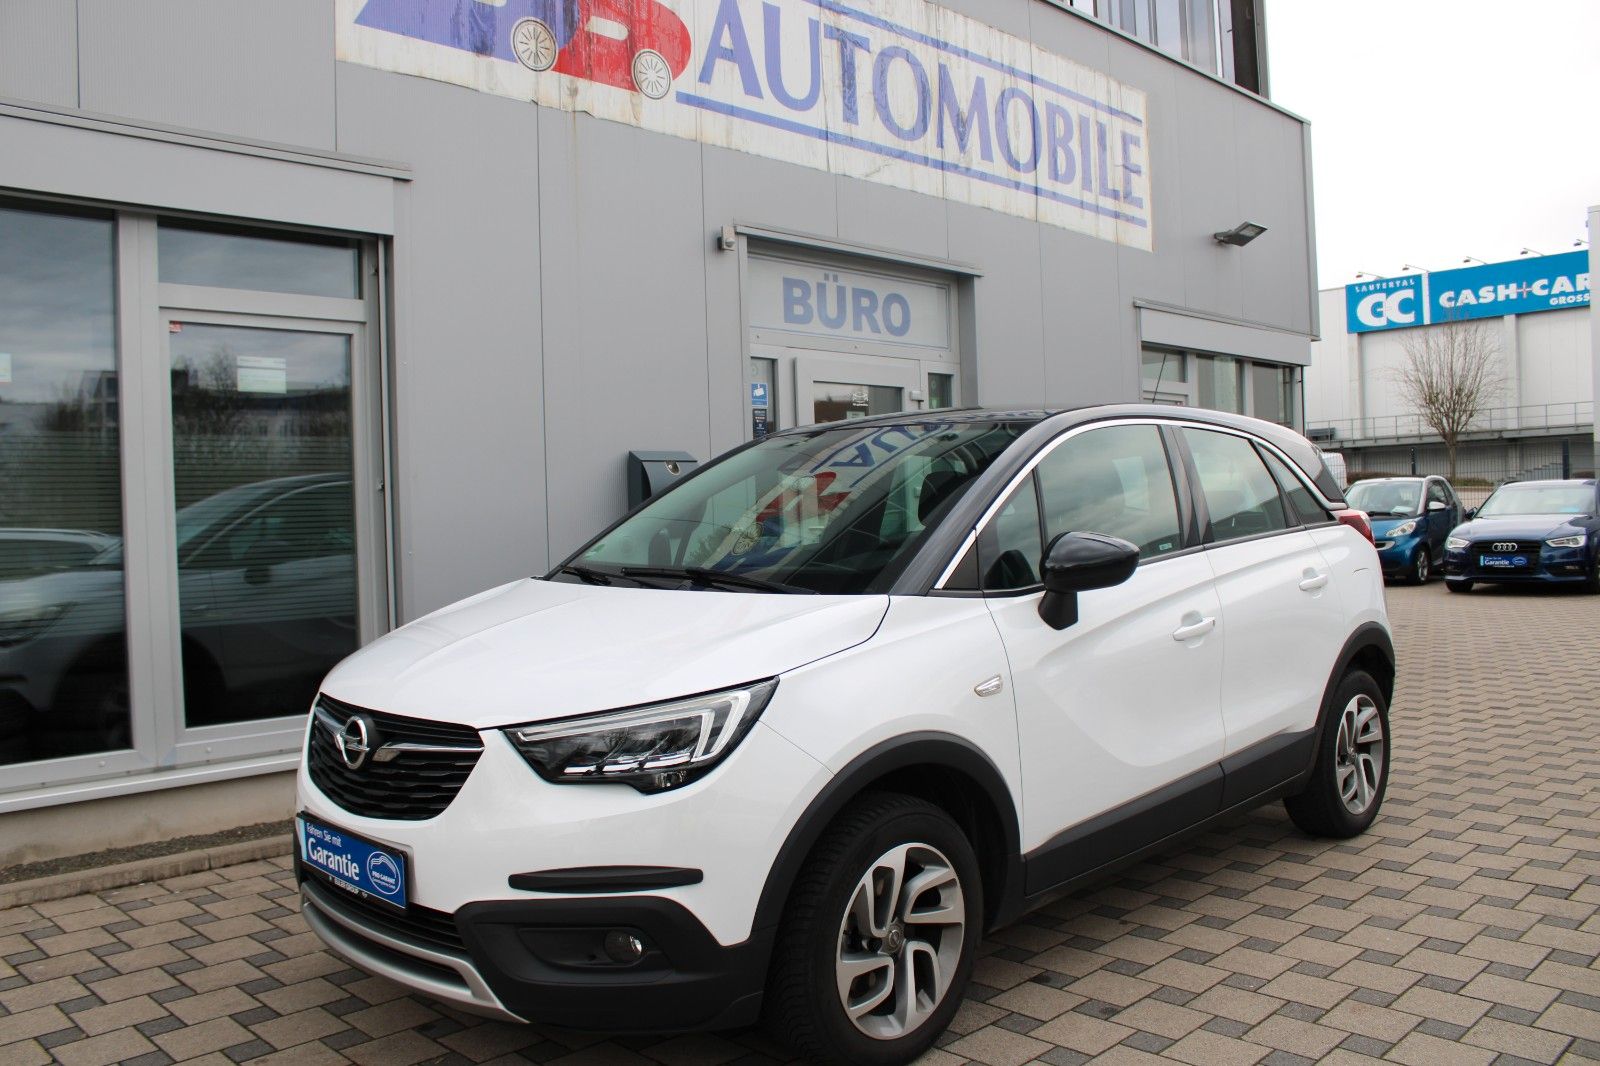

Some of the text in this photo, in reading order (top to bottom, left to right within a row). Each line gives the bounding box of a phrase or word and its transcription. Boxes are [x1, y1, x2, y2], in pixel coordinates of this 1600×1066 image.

[698, 0, 1143, 209] AUTOMOBILE
[782, 273, 911, 337] BÜRO
[1355, 279, 1415, 293] LAUTERTAL
[308, 837, 360, 881] Garantie
